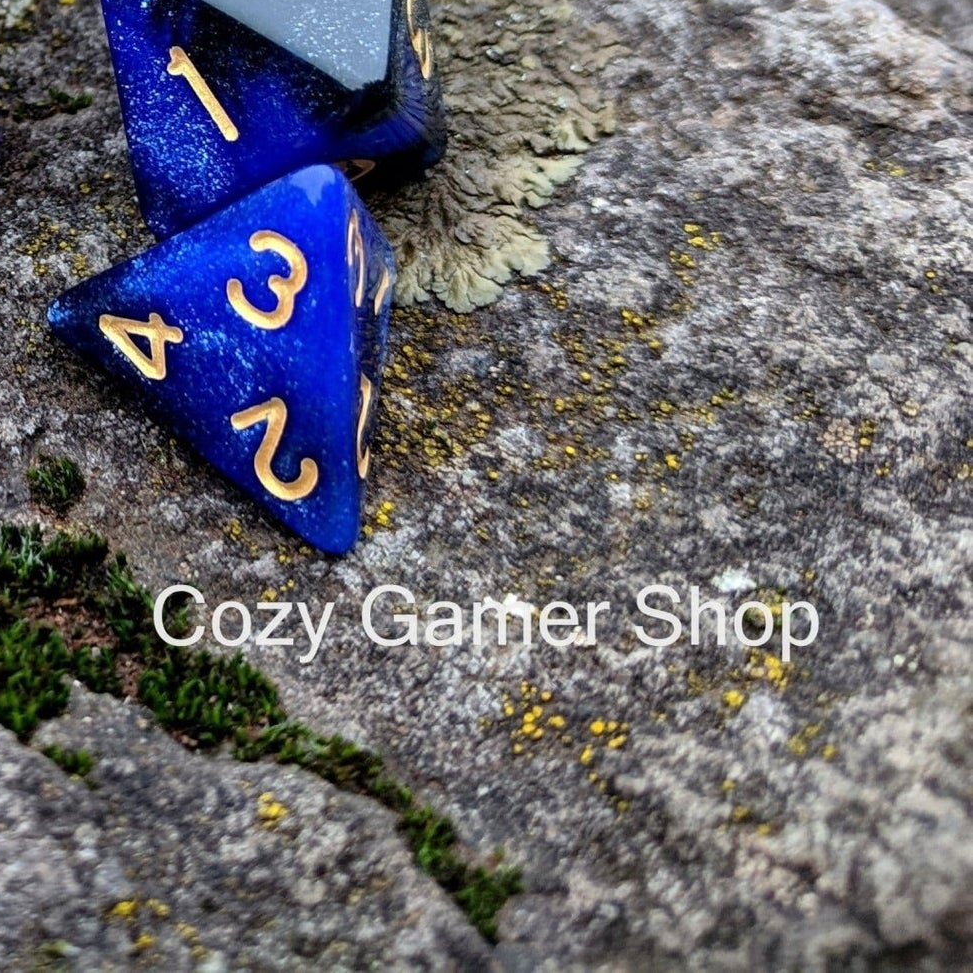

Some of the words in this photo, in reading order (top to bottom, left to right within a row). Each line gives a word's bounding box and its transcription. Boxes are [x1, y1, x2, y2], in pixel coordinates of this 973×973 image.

[166, 45, 240, 143] 1
[225, 229, 308, 330] 3
[98, 312, 184, 381] 4
[230, 396, 319, 502] 2
